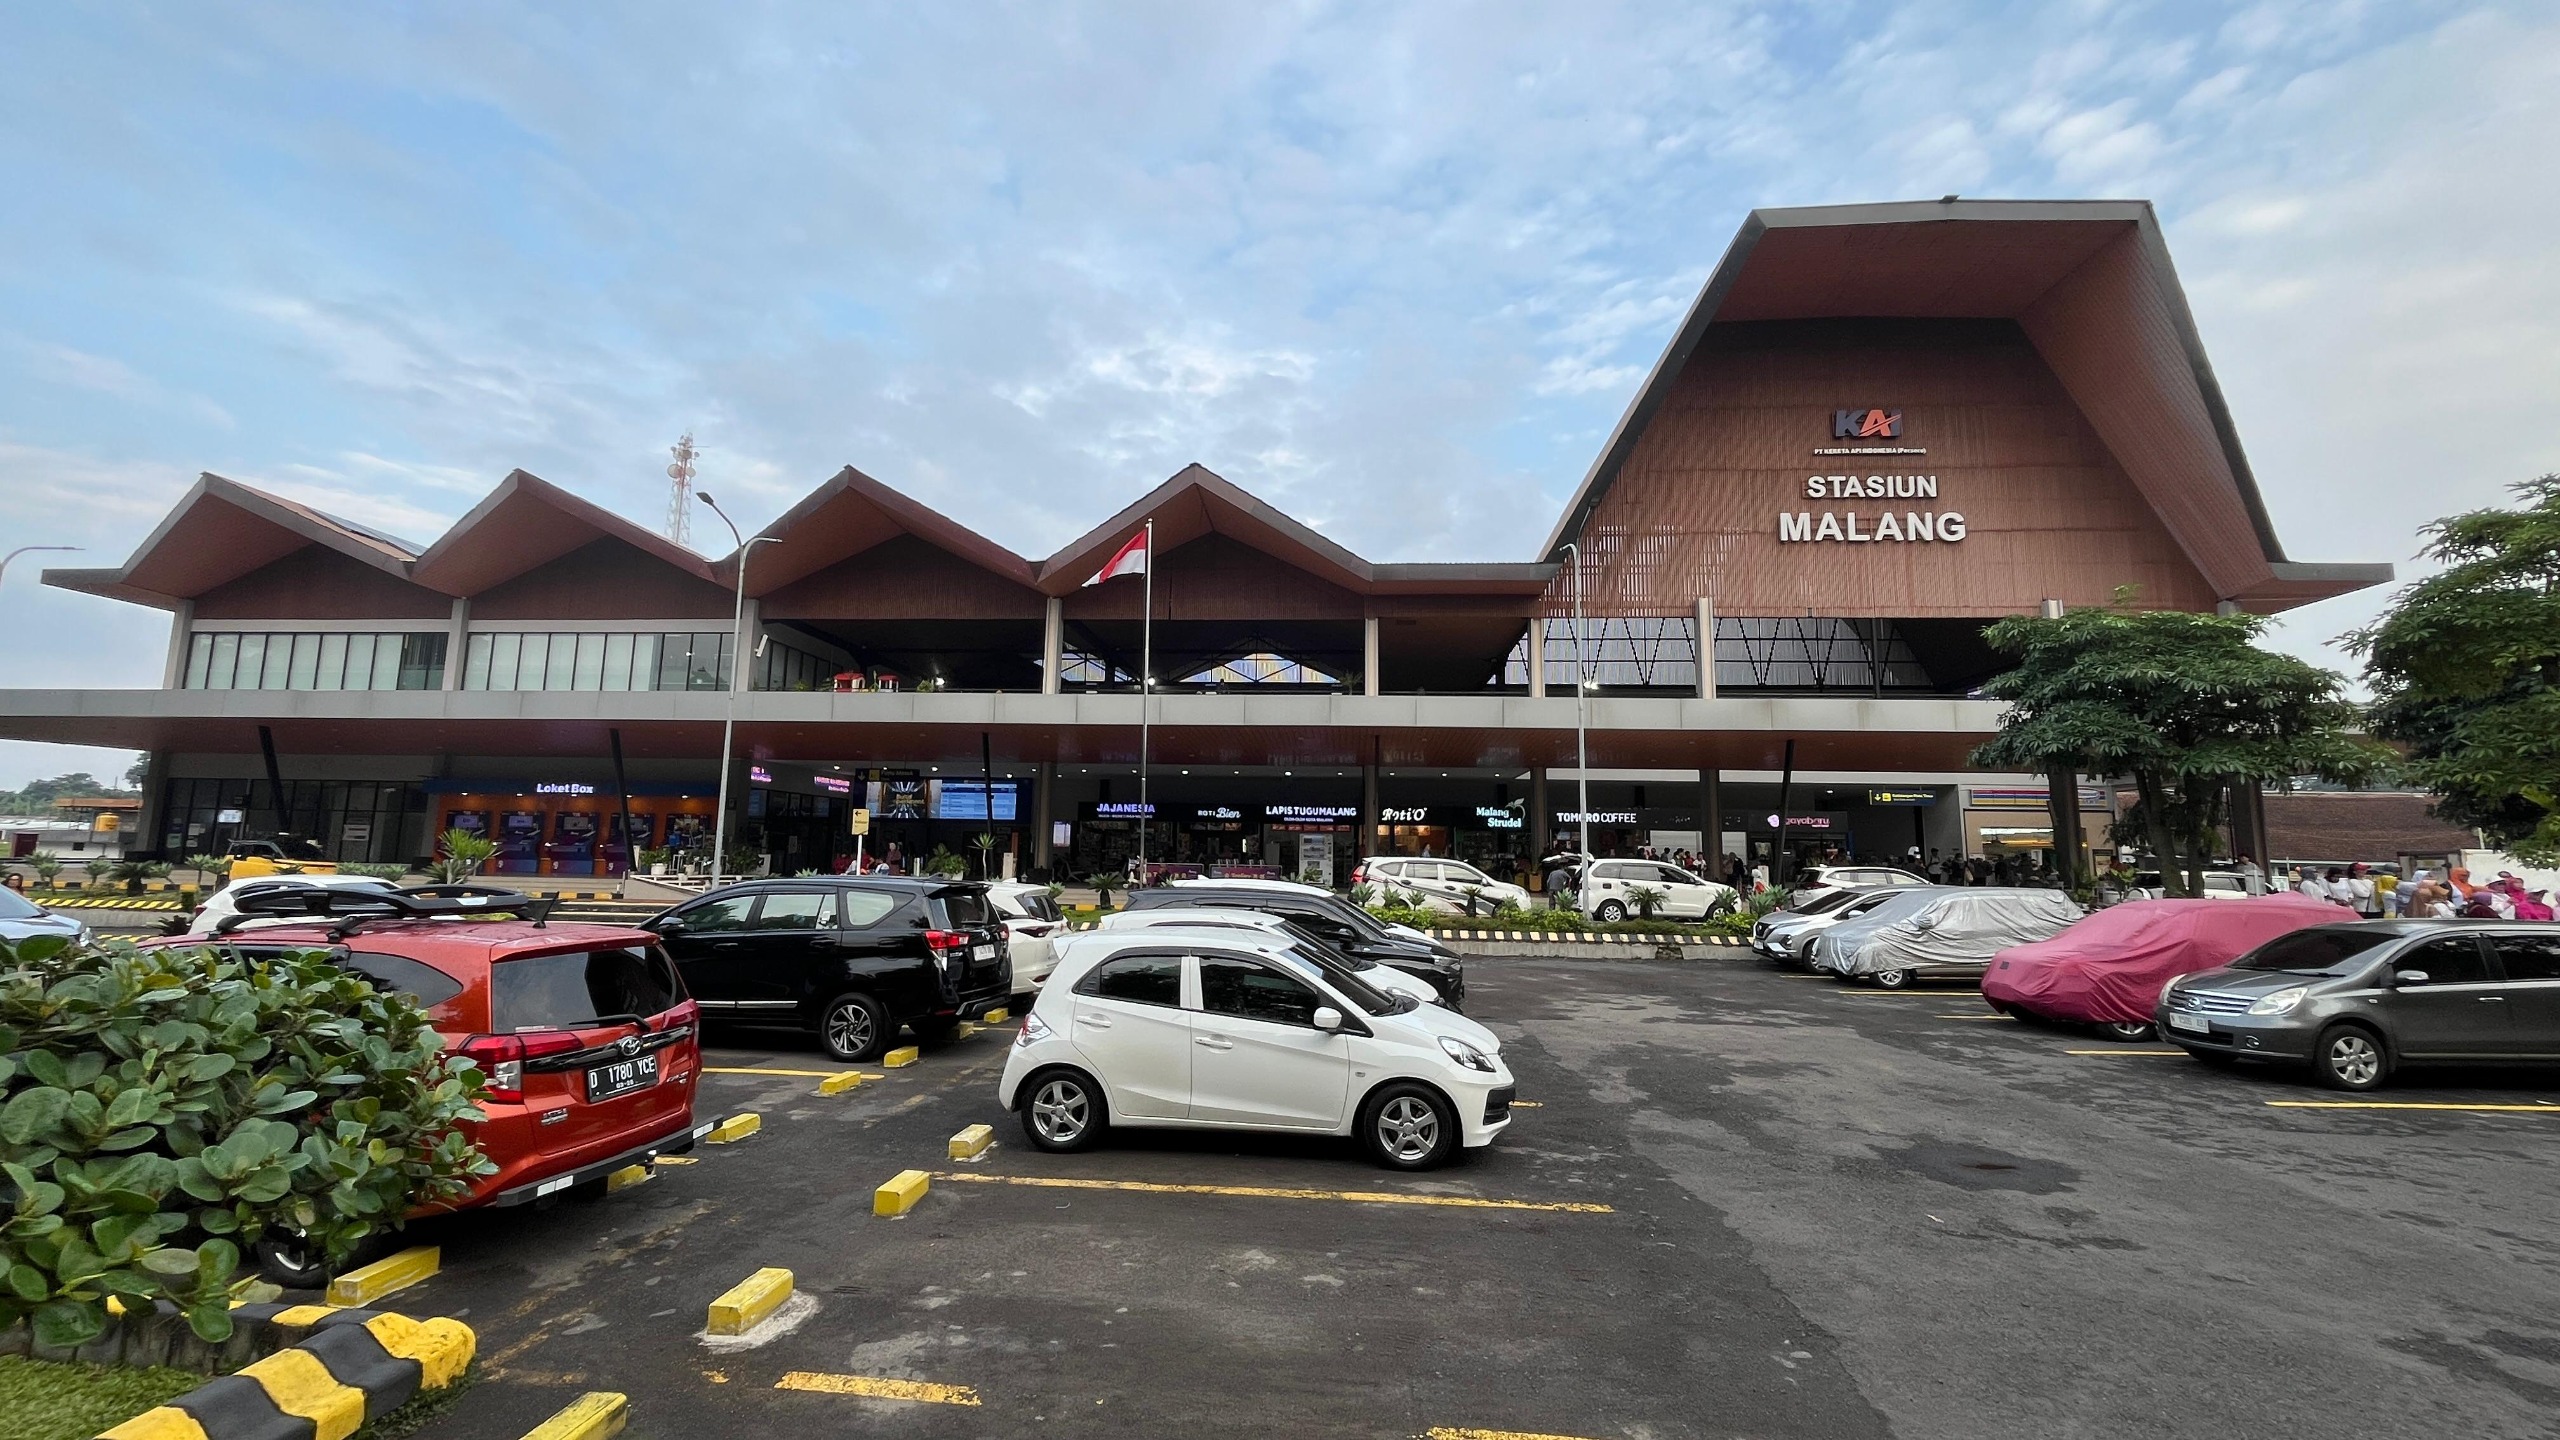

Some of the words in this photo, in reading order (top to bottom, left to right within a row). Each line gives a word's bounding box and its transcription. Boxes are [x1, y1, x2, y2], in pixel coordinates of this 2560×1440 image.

[1834, 408, 1903, 438] KAI
[1807, 475, 1938, 498] STASIUN
[1779, 512, 1966, 542] MALANG
[536, 783, 570, 793] Loket
[571, 783, 594, 794] Box
[1096, 803, 1156, 813] JAJANESIA
[1216, 807, 1241, 819] Bien
[1265, 805, 1293, 815] LAPIS
[1476, 806, 1509, 818] Malang
[1487, 817, 1522, 828] Strudel
[1556, 812, 1600, 823] TOMRO
[1600, 812, 1637, 823] COFFEE
[590, 1071, 598, 1089] D
[608, 1063, 633, 1083] 1780
[637, 1057, 656, 1076] YCE
